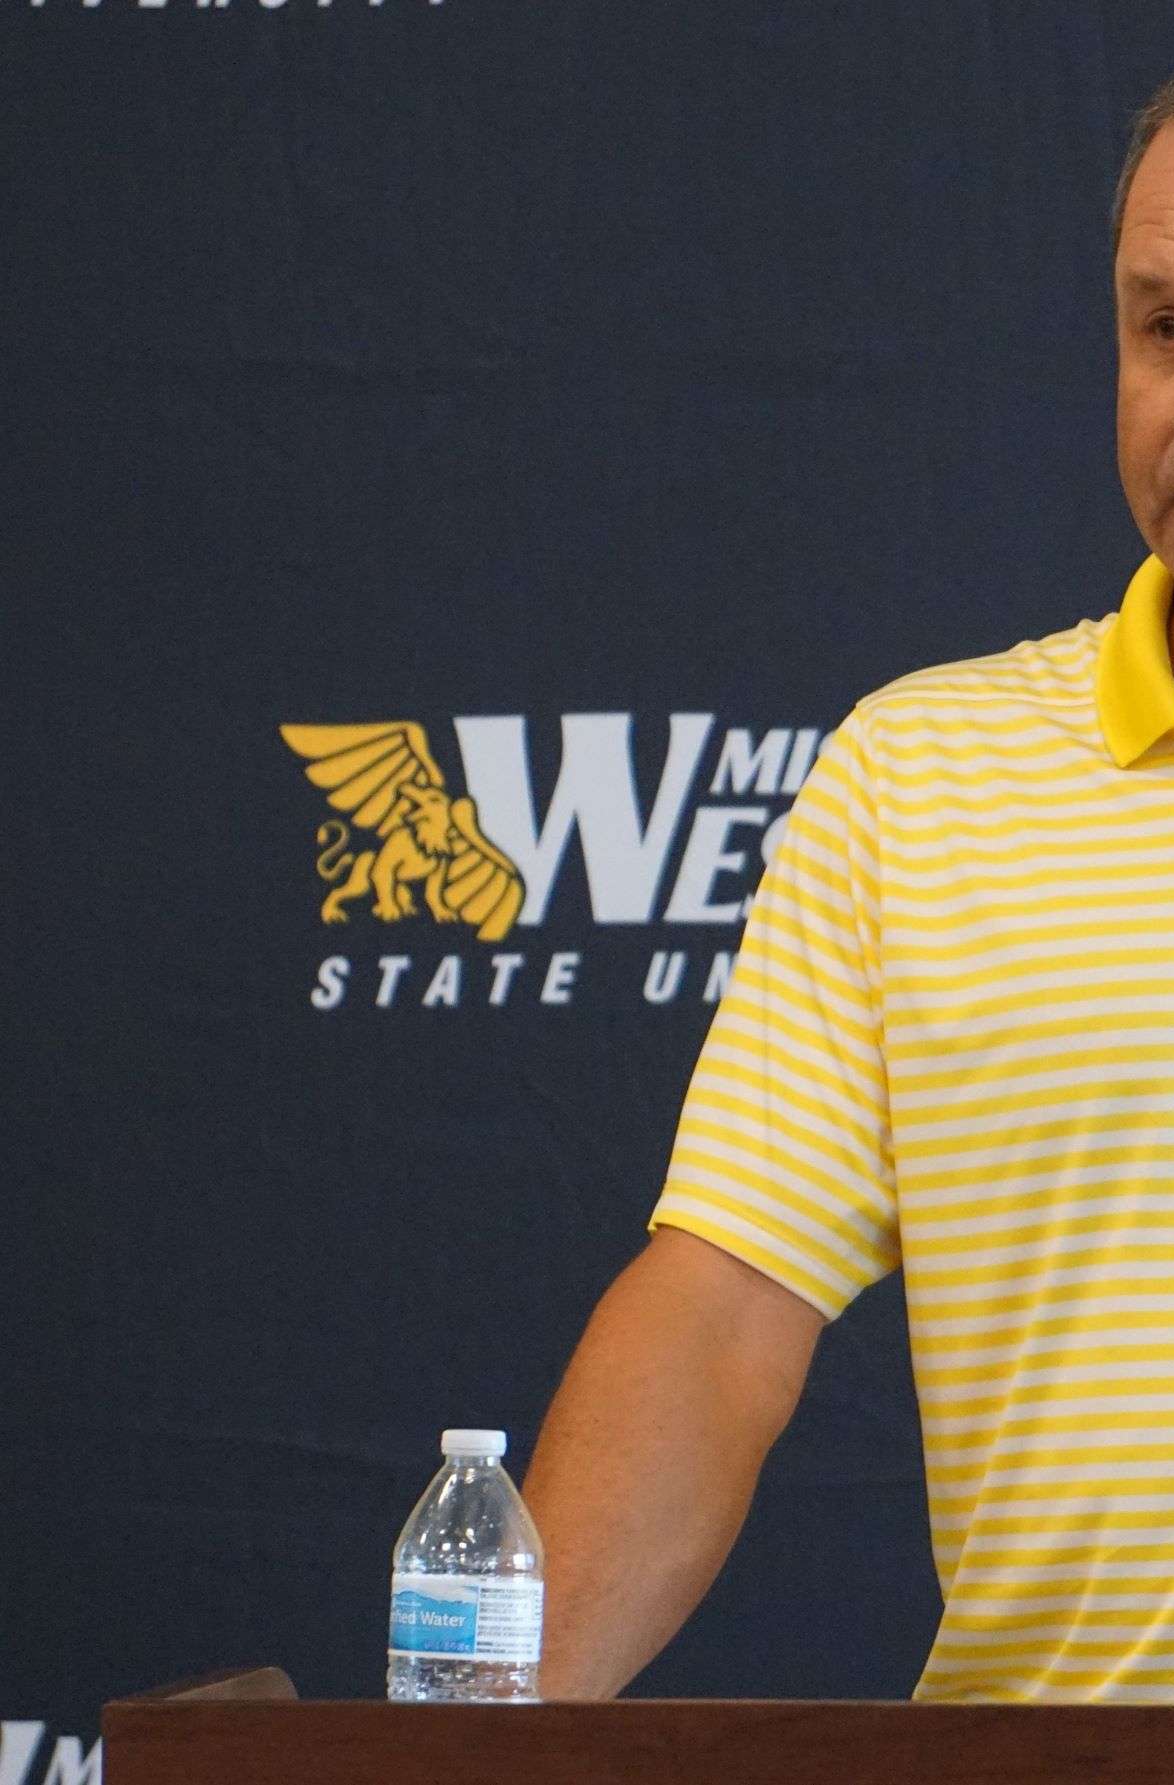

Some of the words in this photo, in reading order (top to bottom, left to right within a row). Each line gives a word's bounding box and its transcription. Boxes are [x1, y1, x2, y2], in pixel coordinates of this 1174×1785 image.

[709, 728, 836, 795] MI
[311, 951, 580, 1009] STATE
[421, 1611, 466, 1627] Water
